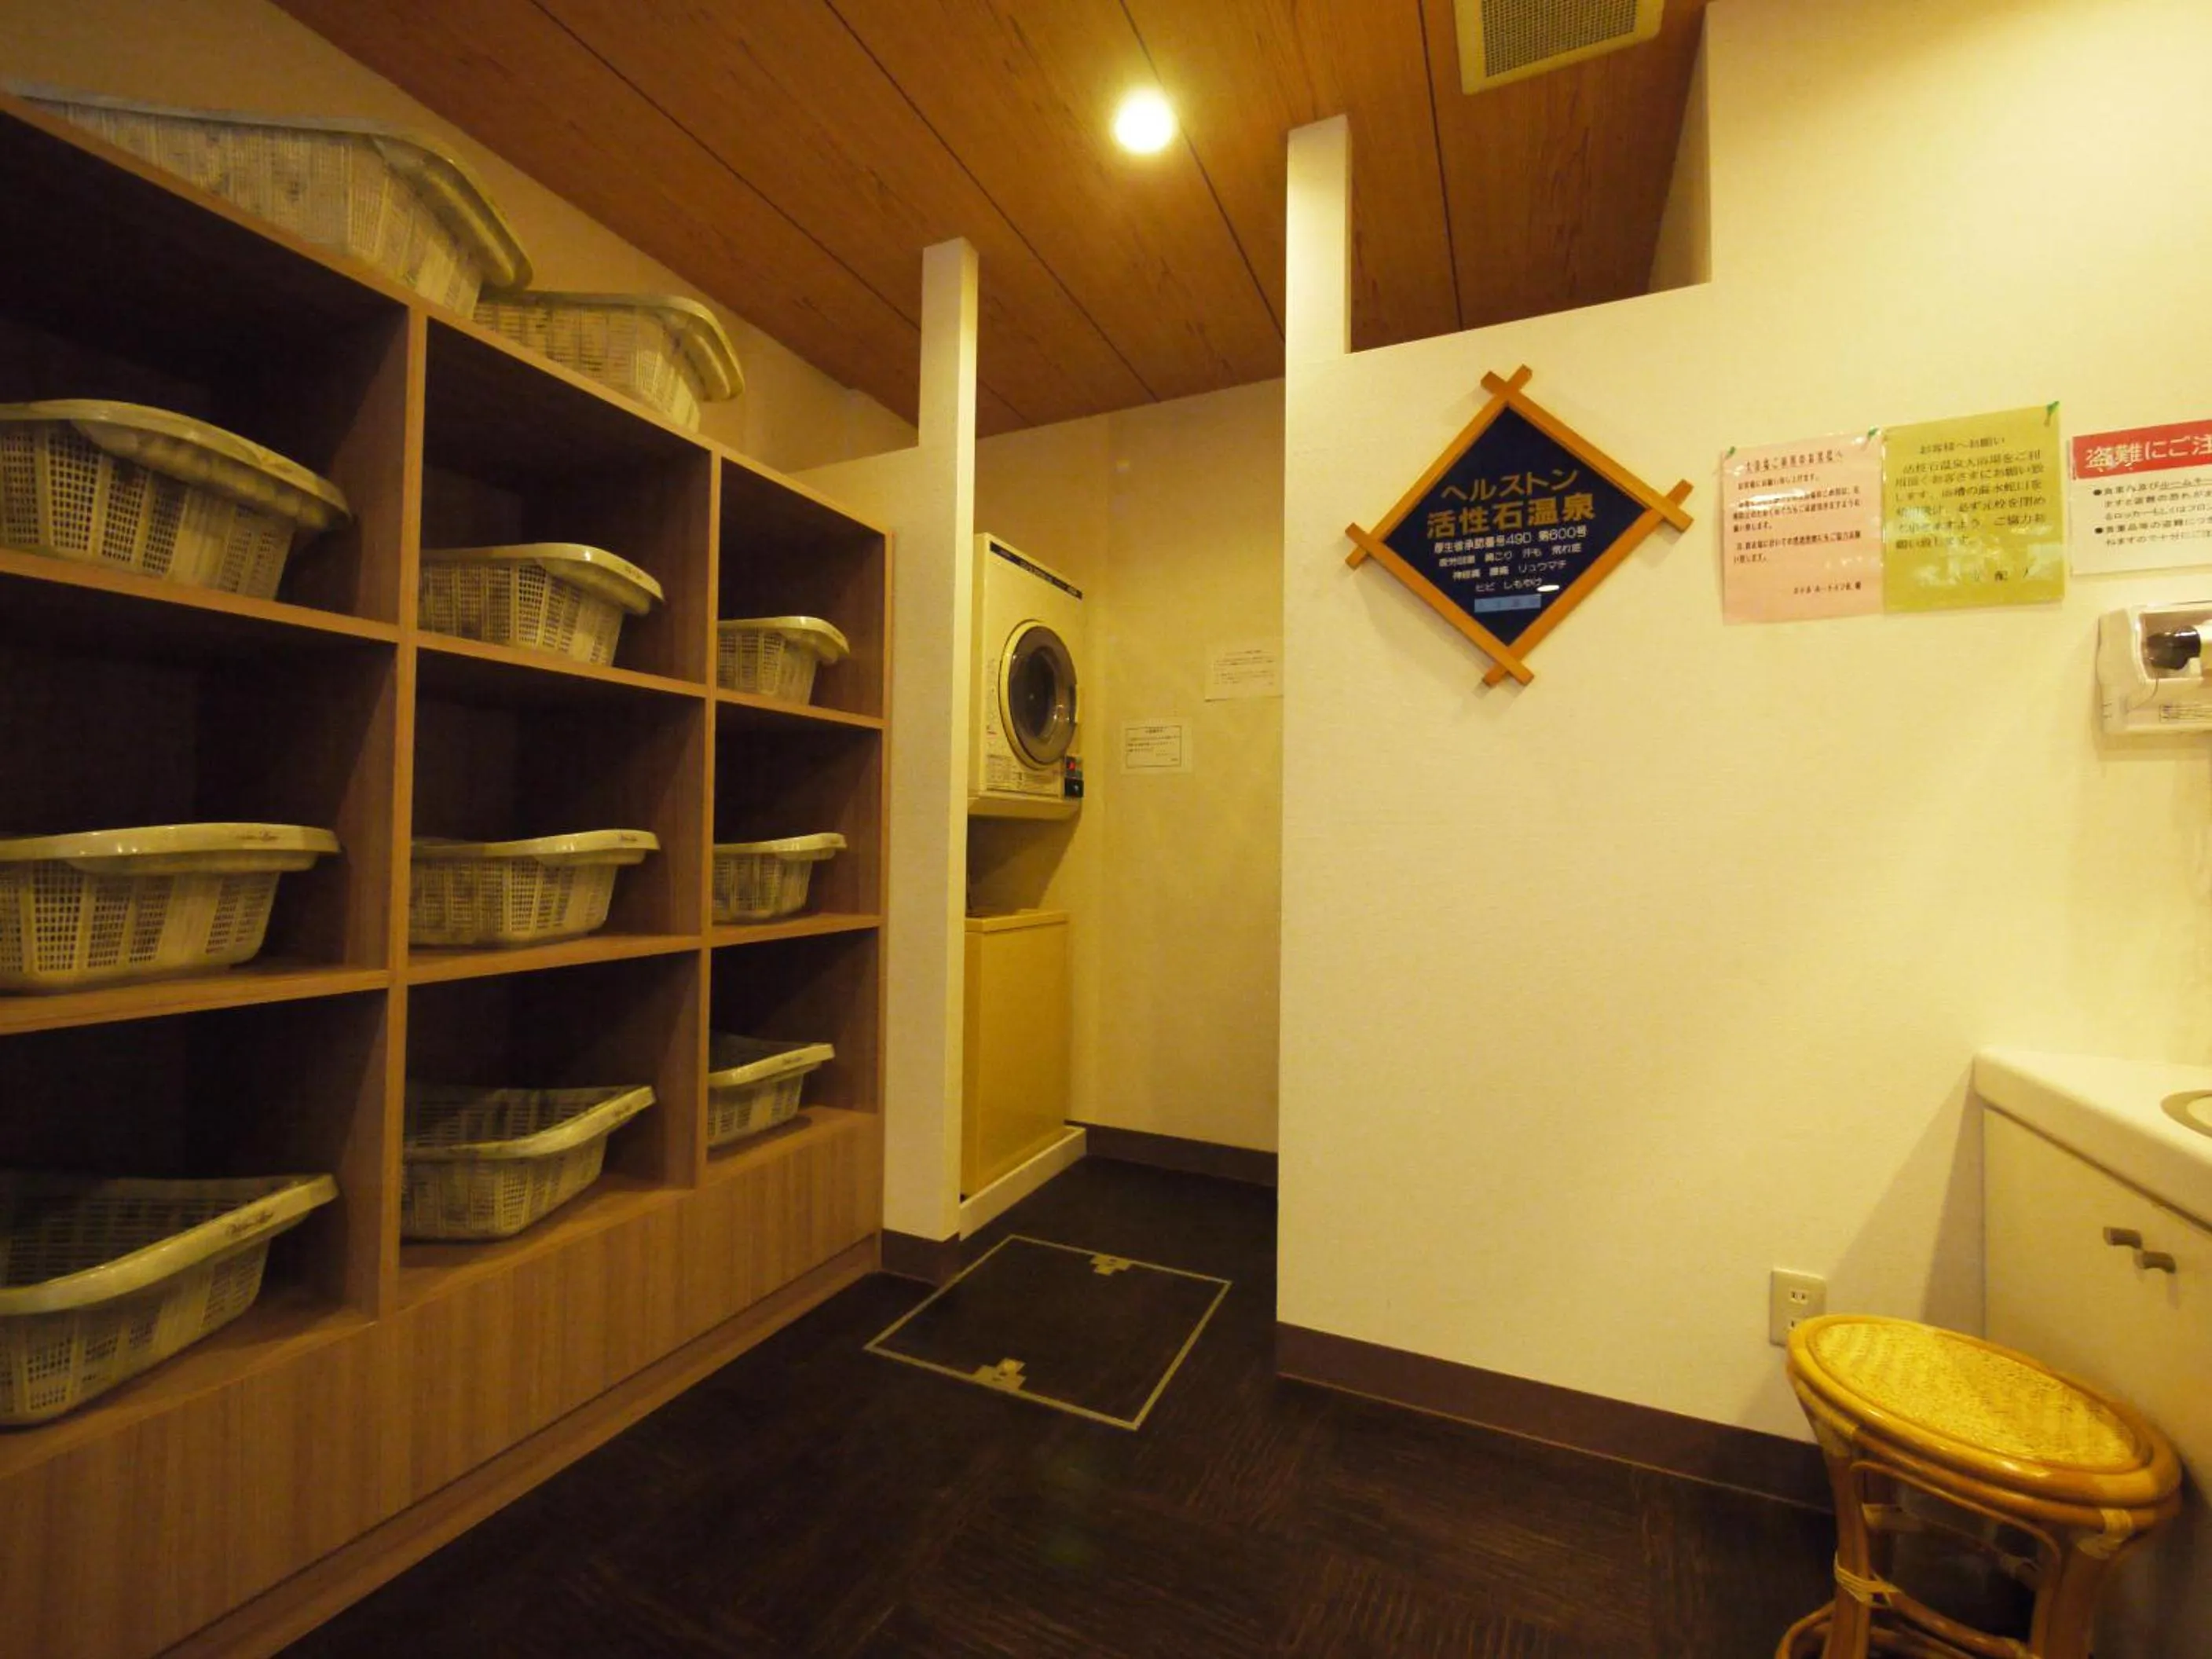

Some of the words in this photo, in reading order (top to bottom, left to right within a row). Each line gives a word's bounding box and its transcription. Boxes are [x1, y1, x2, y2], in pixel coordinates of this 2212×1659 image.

[1441, 470, 1577, 502] ヘルストン
[1426, 492, 1595, 539] 活性石温泉
[1518, 560, 1566, 573] リュウマチ
